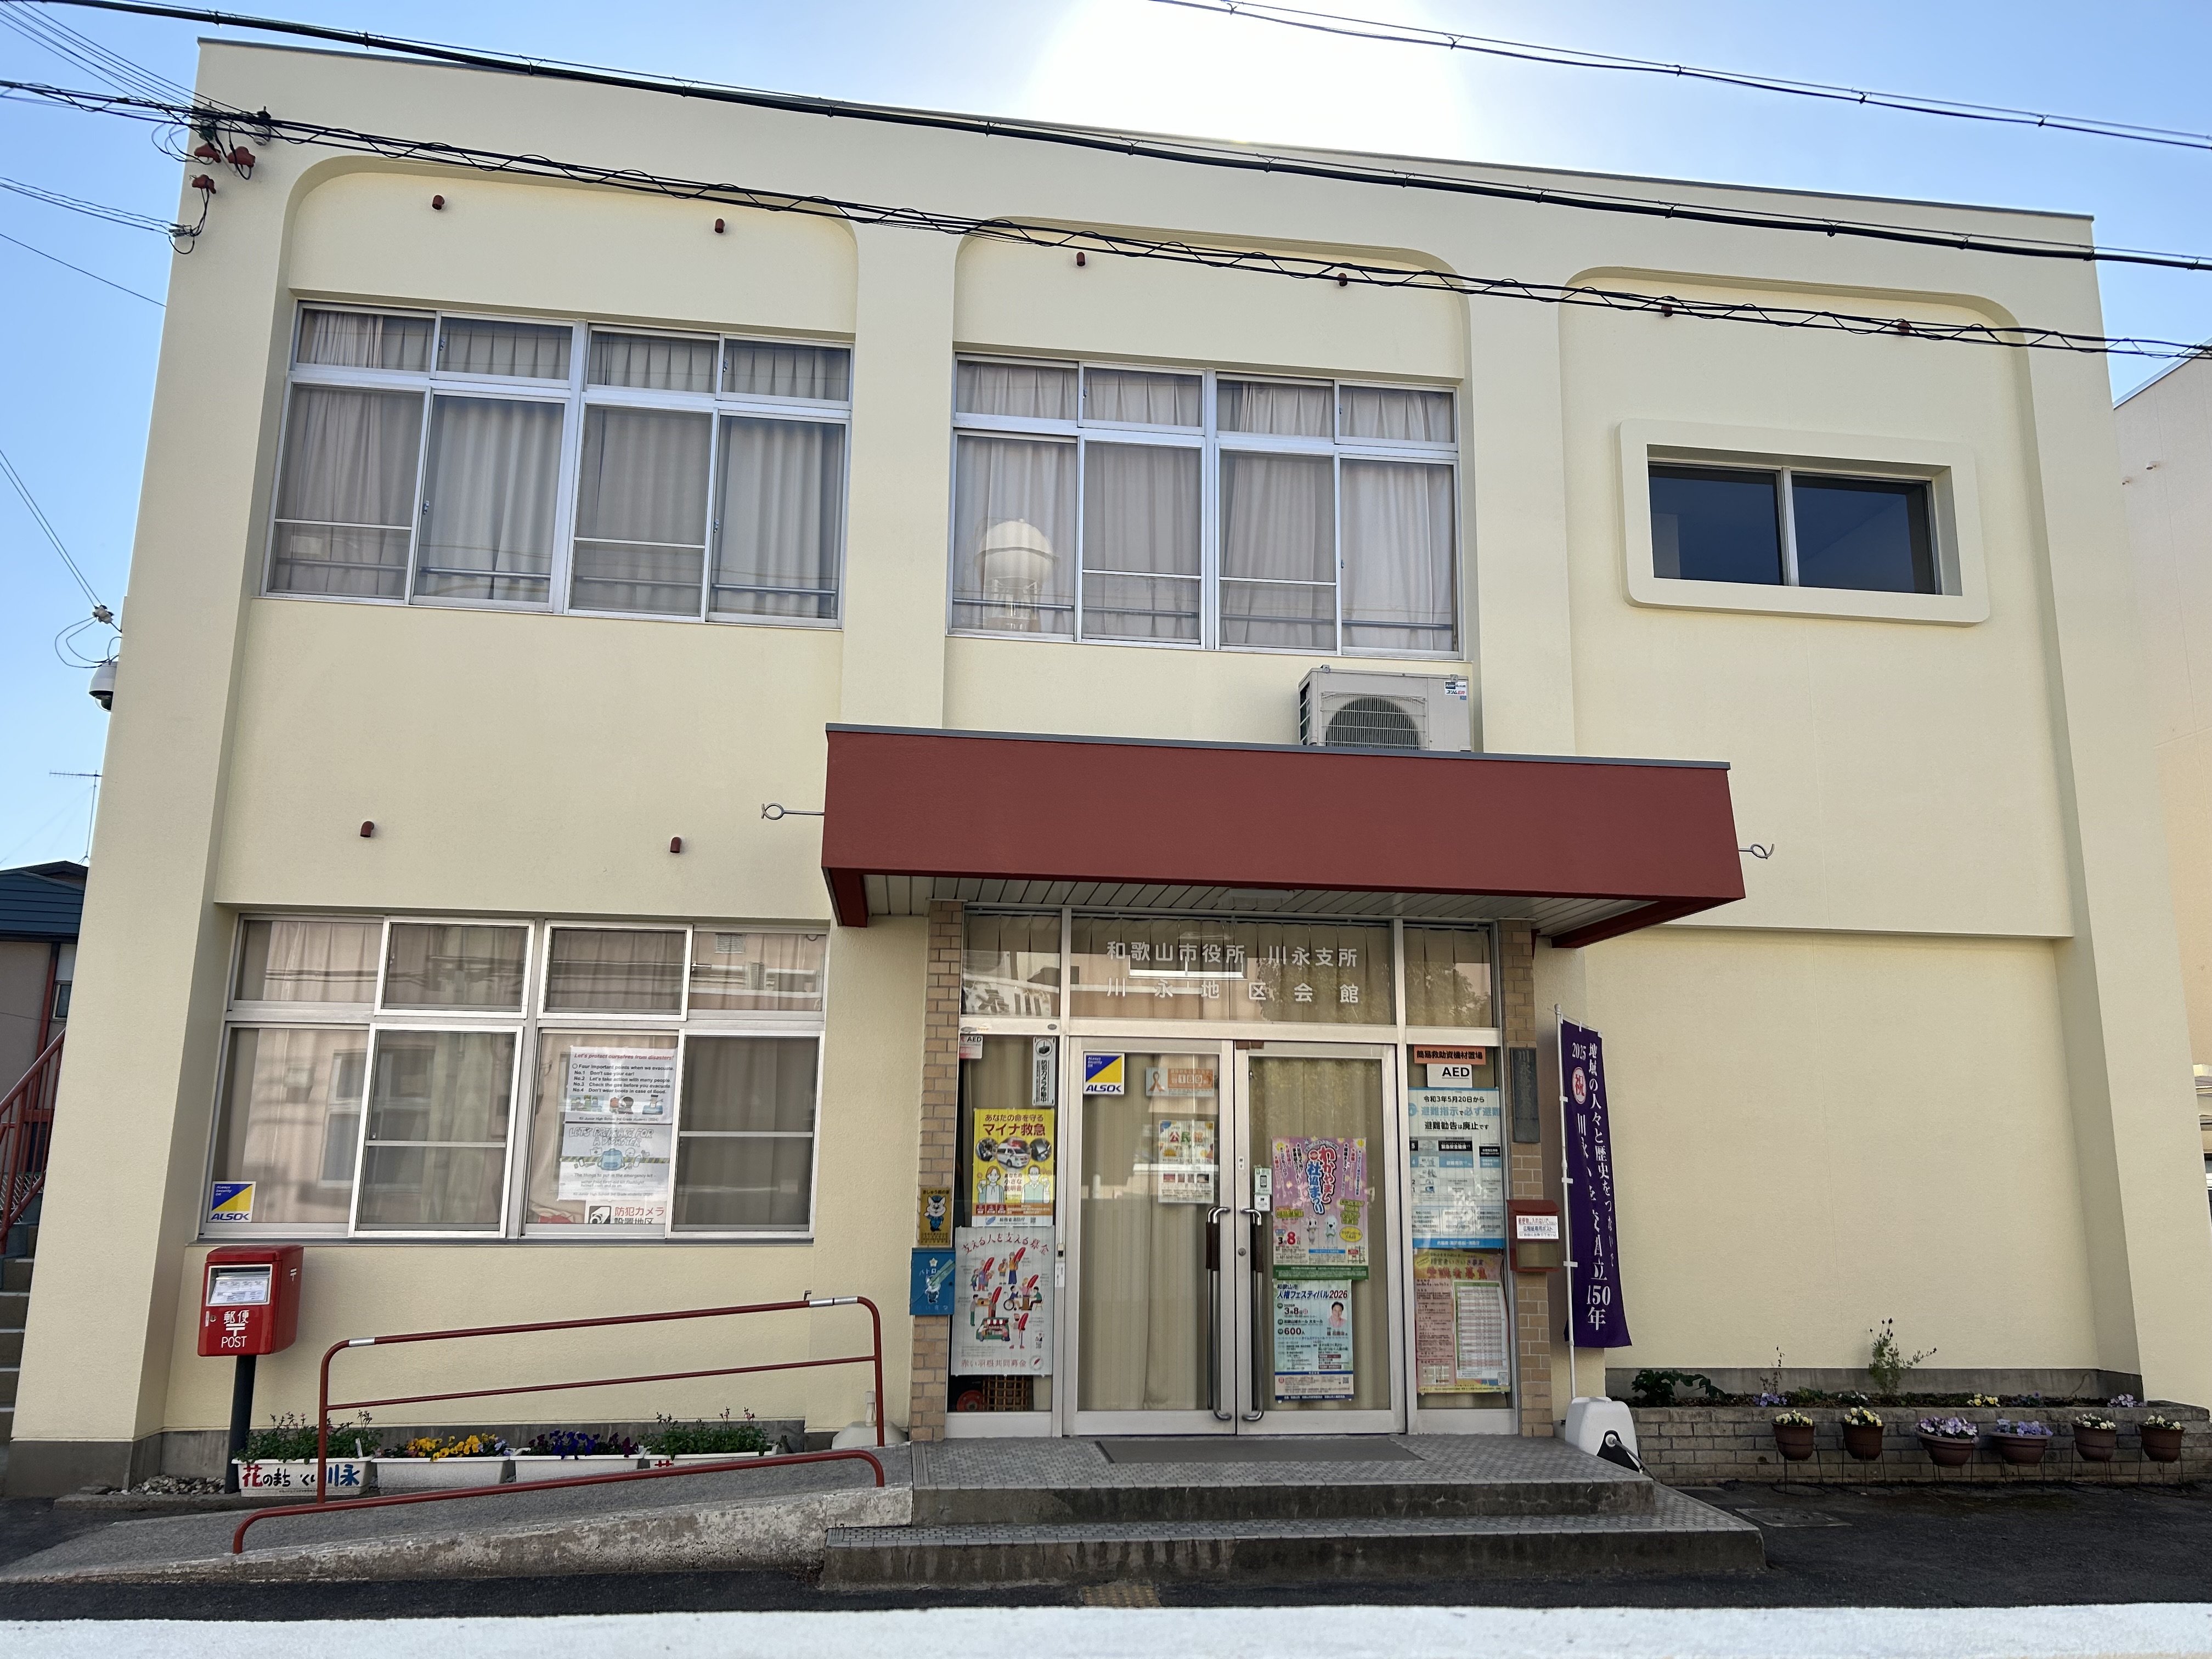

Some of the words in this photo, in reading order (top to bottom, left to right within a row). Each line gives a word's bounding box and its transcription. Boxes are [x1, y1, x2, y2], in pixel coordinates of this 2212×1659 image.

[1107, 941, 1245, 964] 和歌山市役所
[1268, 945, 1358, 967] 川永支所
[1107, 977, 1359, 1003] 川永地区会館
[1572, 1042, 1585, 1060] 2025
[1442, 1067, 1470, 1077] AED
[1575, 1074, 1585, 1097] 祝
[1421, 1106, 1500, 1116] 避難指示で必ず避難
[985, 1114, 1043, 1122] あなたの命を守る
[983, 1123, 1045, 1136] マイナ救急
[1425, 1121, 1489, 1130] 避難勧告は廃止です
[1319, 1146, 1336, 1203] わかやまし
[614, 1206, 664, 1216] 防犯カメラ
[961, 1232, 1049, 1255] 支える人と支える募金
[223, 1310, 250, 1324] 郵便
[221, 1336, 247, 1348] POST
[961, 1358, 1027, 1368] 赤い羽根共同募金
